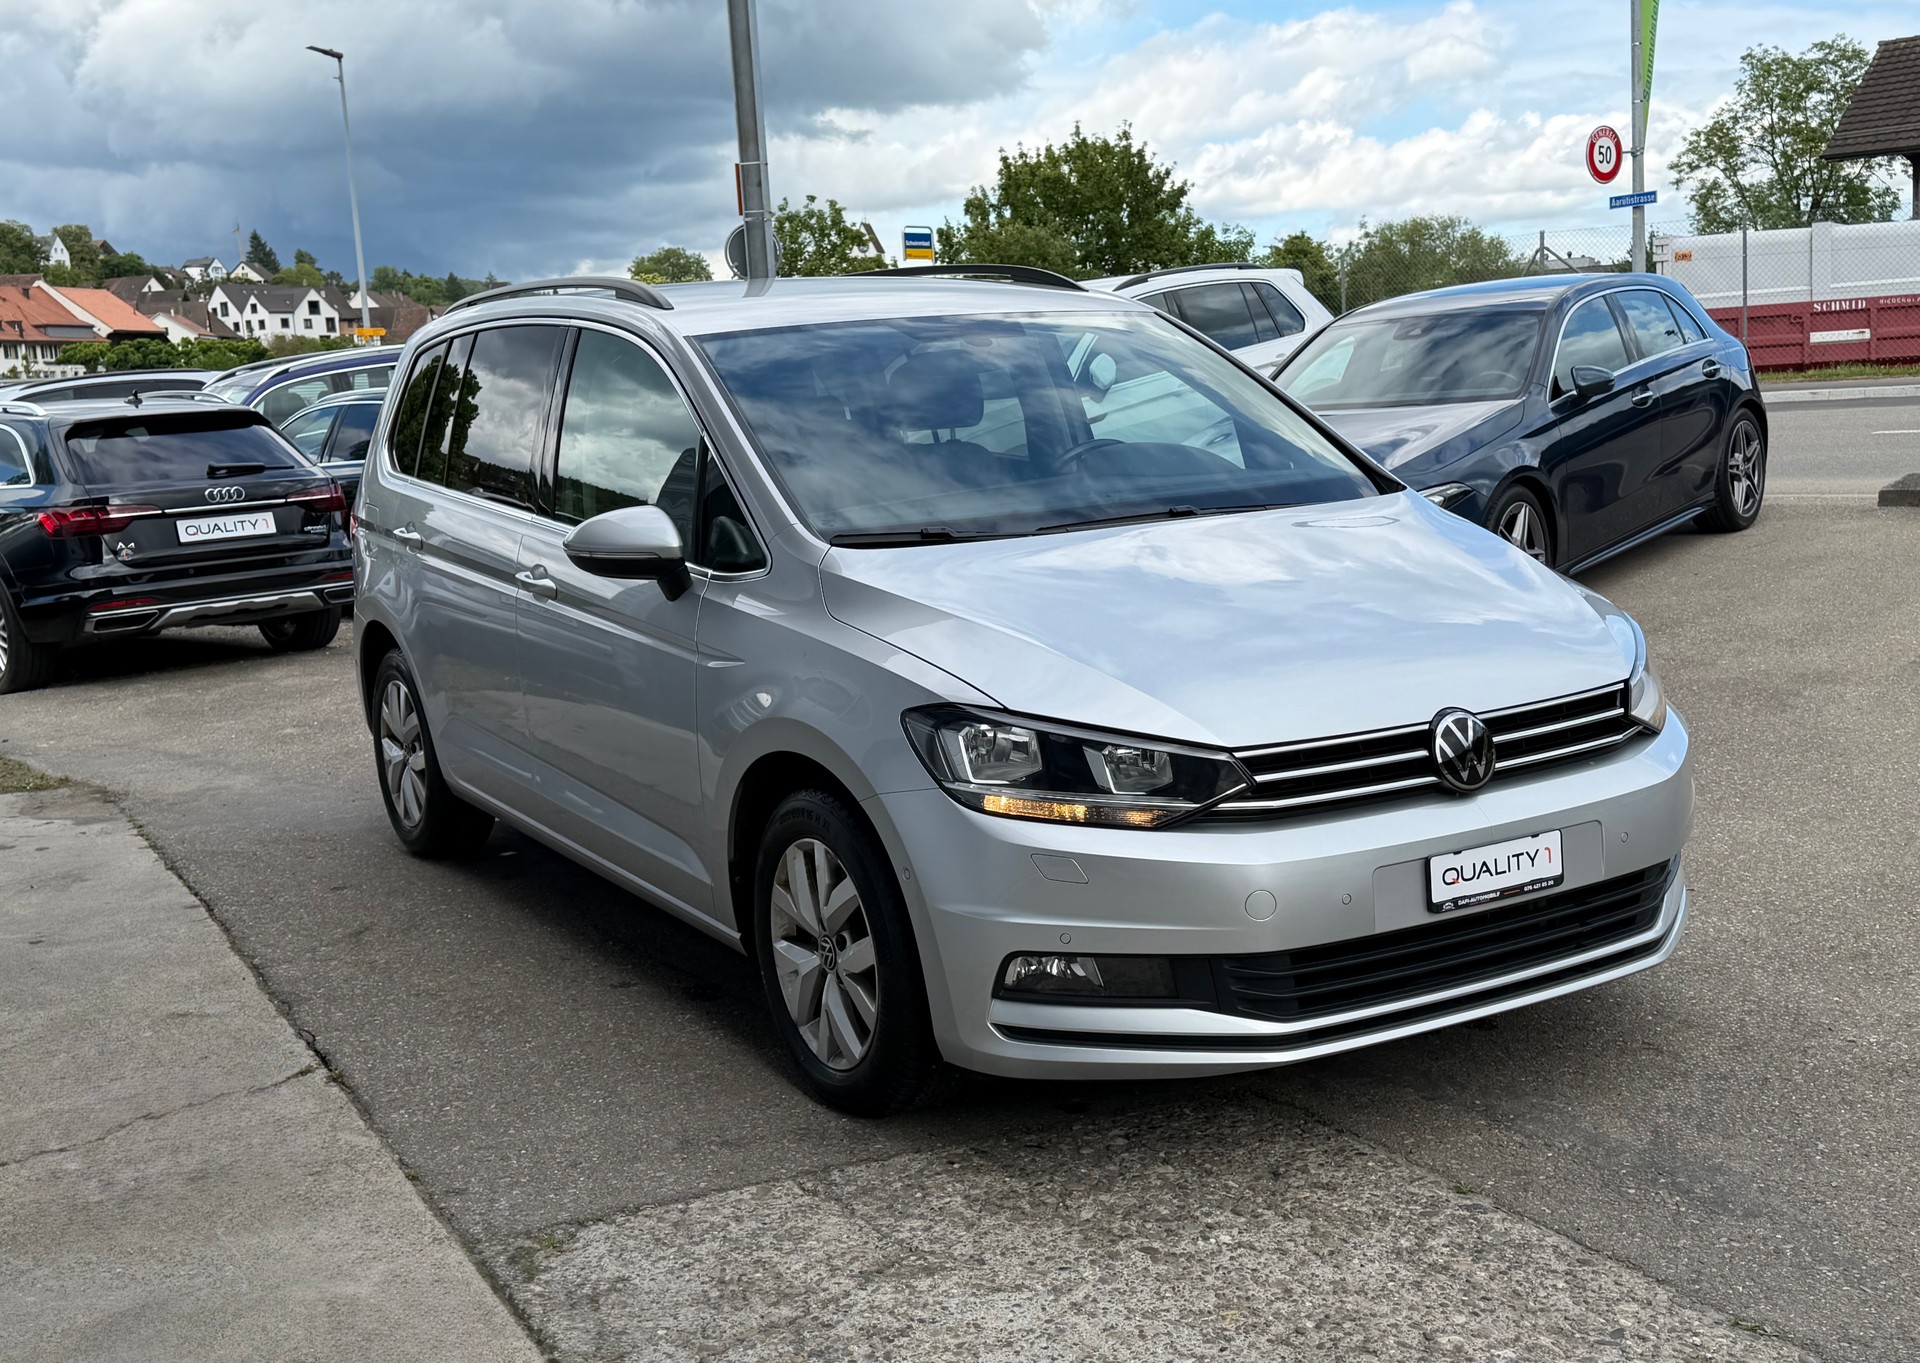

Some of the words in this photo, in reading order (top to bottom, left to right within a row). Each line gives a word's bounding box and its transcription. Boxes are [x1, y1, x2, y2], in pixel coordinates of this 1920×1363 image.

[1591, 127, 1618, 146] GENERELL
[1598, 145, 1612, 165] 50
[1813, 299, 1867, 312] SCHMID
[185, 518, 259, 537] QUALITY
[262, 517, 270, 529] 1
[116, 541, 136, 551] A4
[1442, 848, 1540, 886] QUALITY
[1543, 846, 1552, 864] 1
